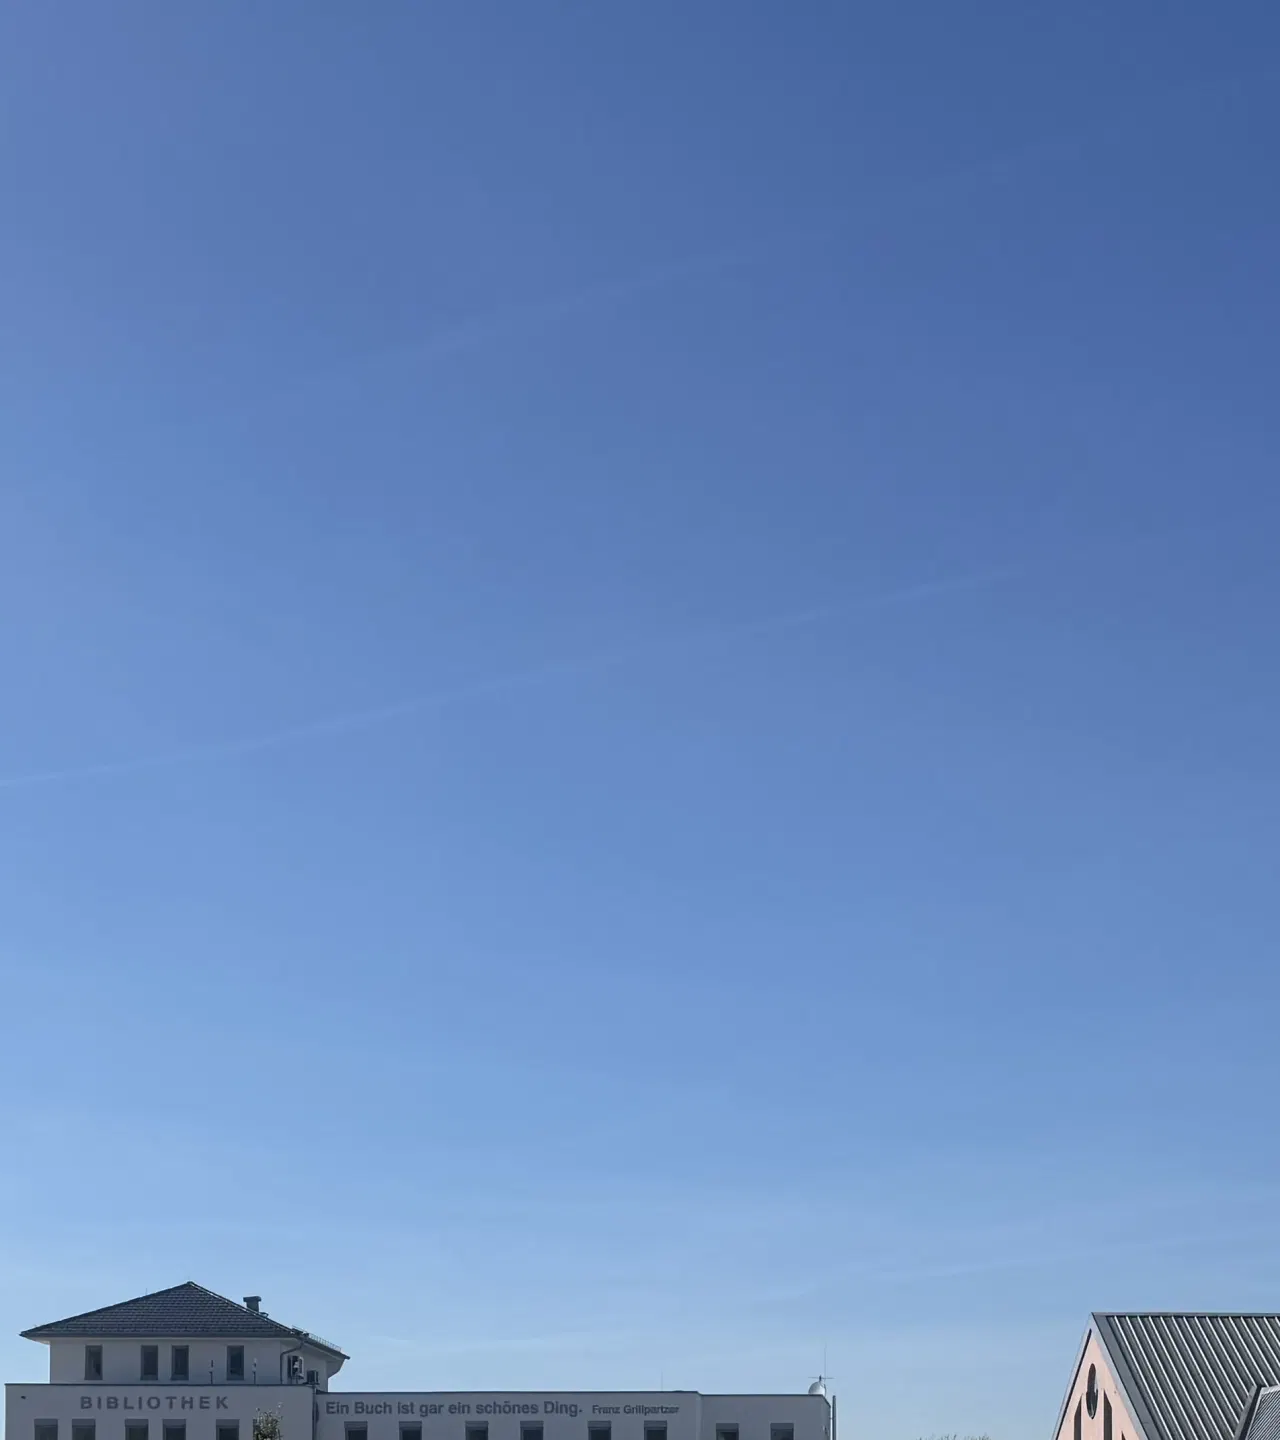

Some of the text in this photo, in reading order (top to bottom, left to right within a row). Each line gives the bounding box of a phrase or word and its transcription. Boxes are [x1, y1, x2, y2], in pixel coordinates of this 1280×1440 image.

[80, 1396, 229, 1410] BIBLIOTHEK
[325, 1402, 350, 1415] Ein
[354, 1402, 393, 1415] Buch
[397, 1402, 415, 1415] ist
[419, 1404, 445, 1417] gar
[448, 1402, 471, 1415] ein
[475, 1401, 539, 1415] schönes
[543, 1401, 583, 1418] Ding.
[592, 1404, 621, 1415] Franz
